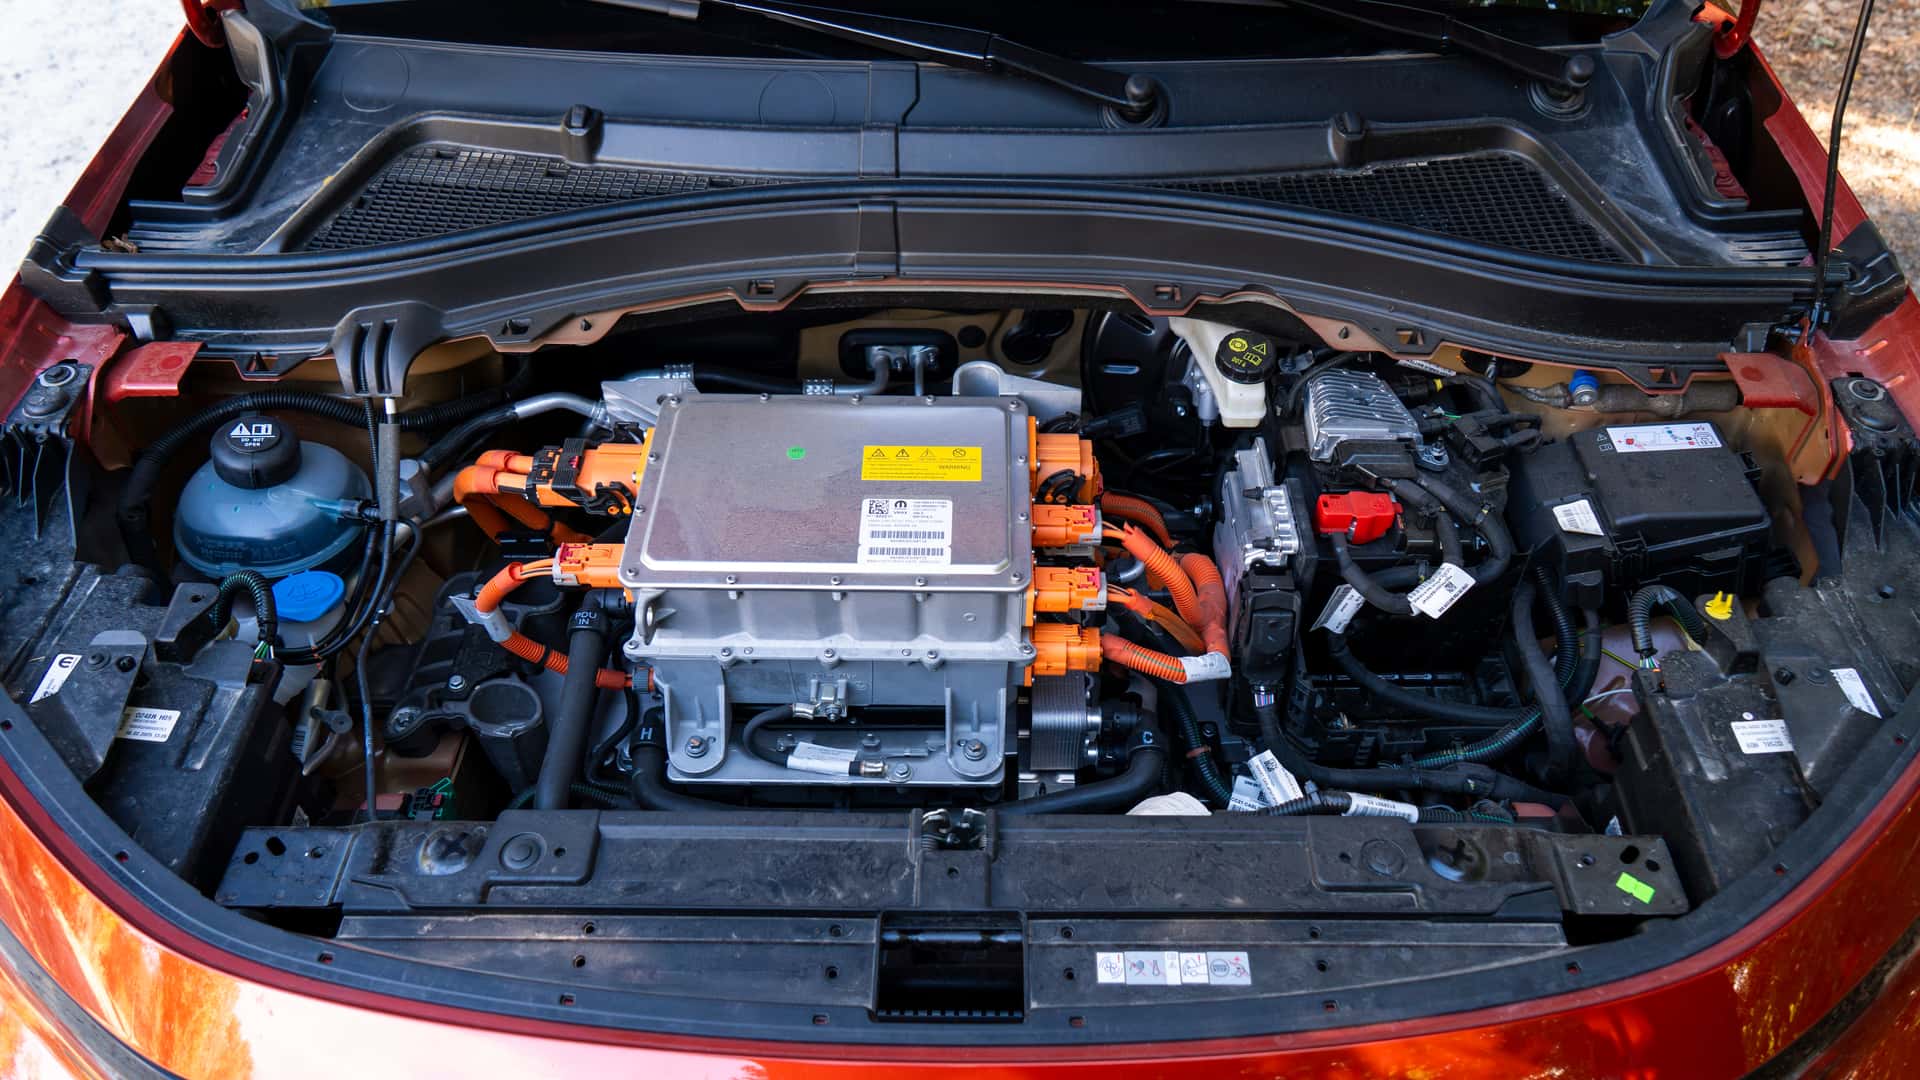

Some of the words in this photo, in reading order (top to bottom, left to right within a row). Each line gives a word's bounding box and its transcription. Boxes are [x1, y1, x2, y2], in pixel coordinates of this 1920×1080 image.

[575, 611, 598, 620] PDU
[640, 727, 653, 740] H
[1143, 731, 1153, 744] C
